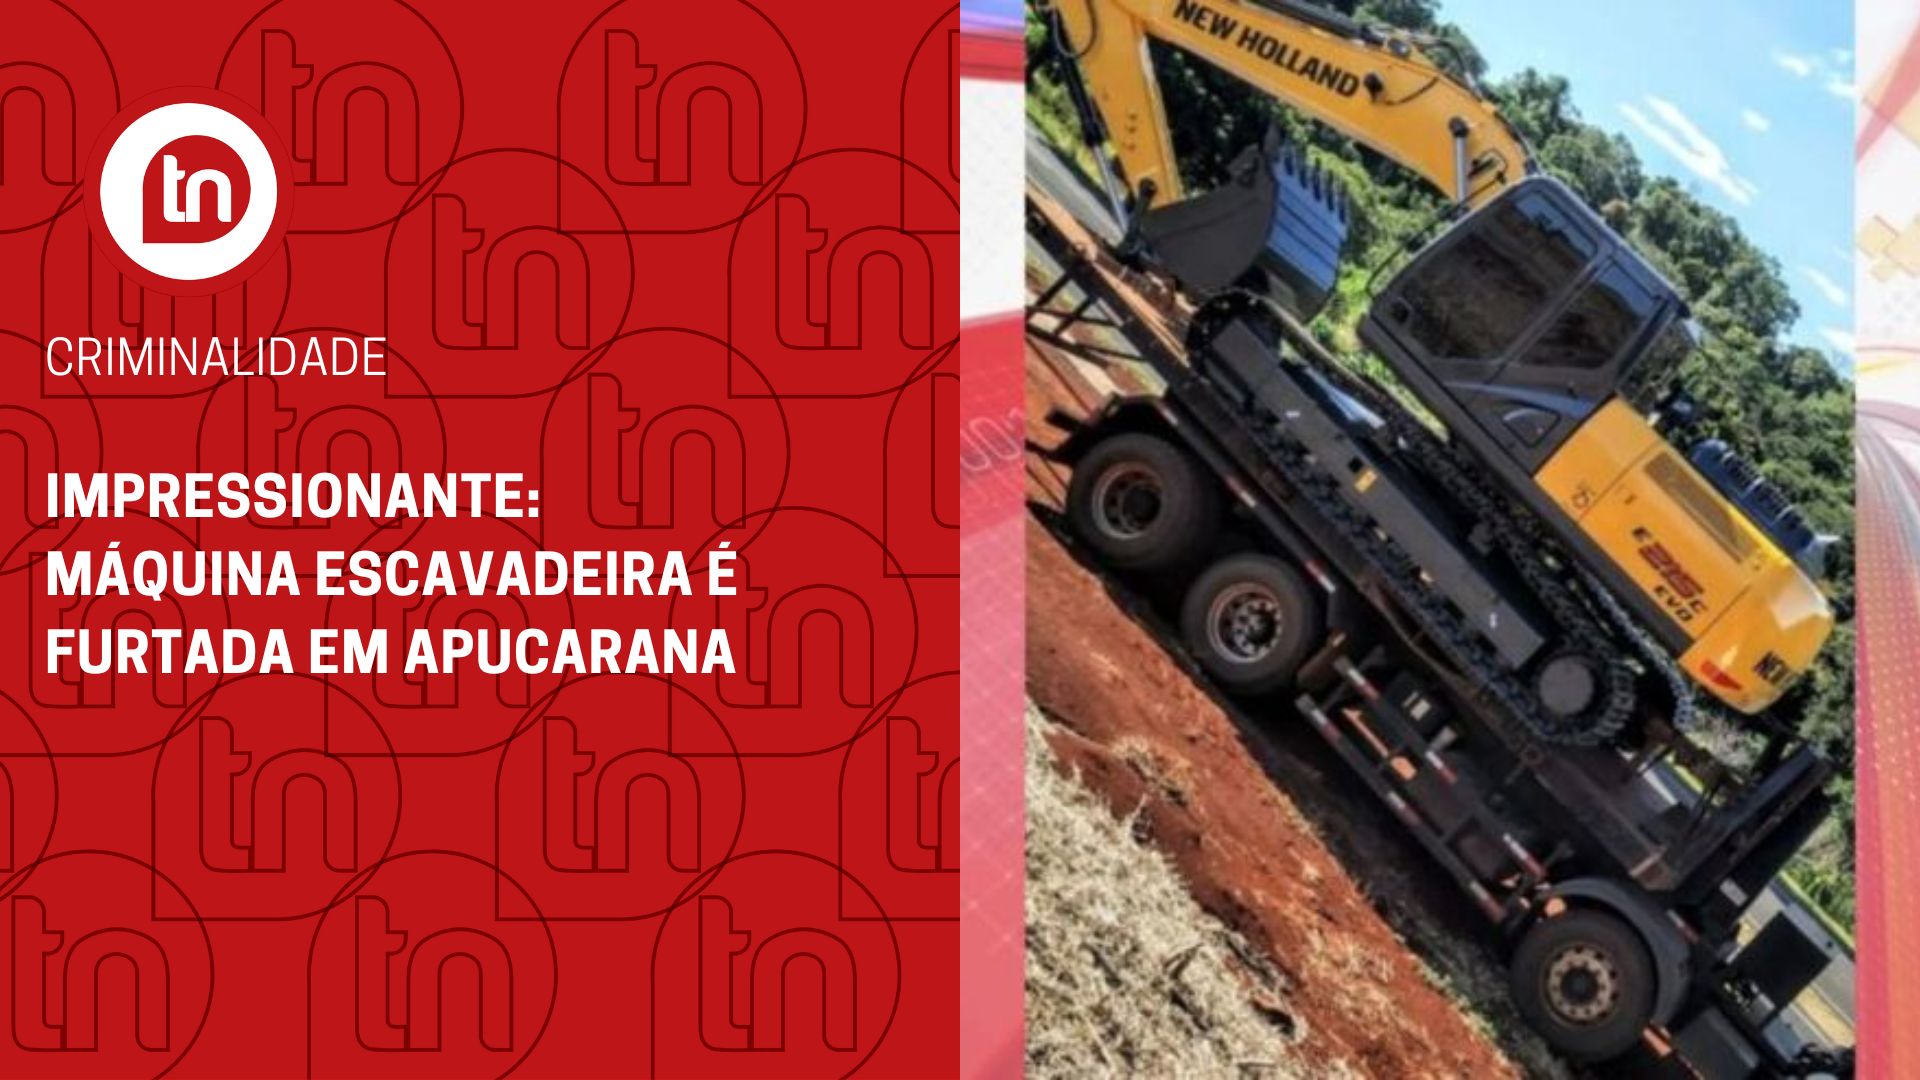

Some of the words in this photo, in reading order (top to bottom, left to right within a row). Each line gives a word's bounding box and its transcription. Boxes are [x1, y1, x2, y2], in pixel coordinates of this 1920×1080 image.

[1173, 0, 1237, 41] NEW
[1236, 24, 1360, 98] HOLLAND
[1654, 585, 1693, 622] EVO
